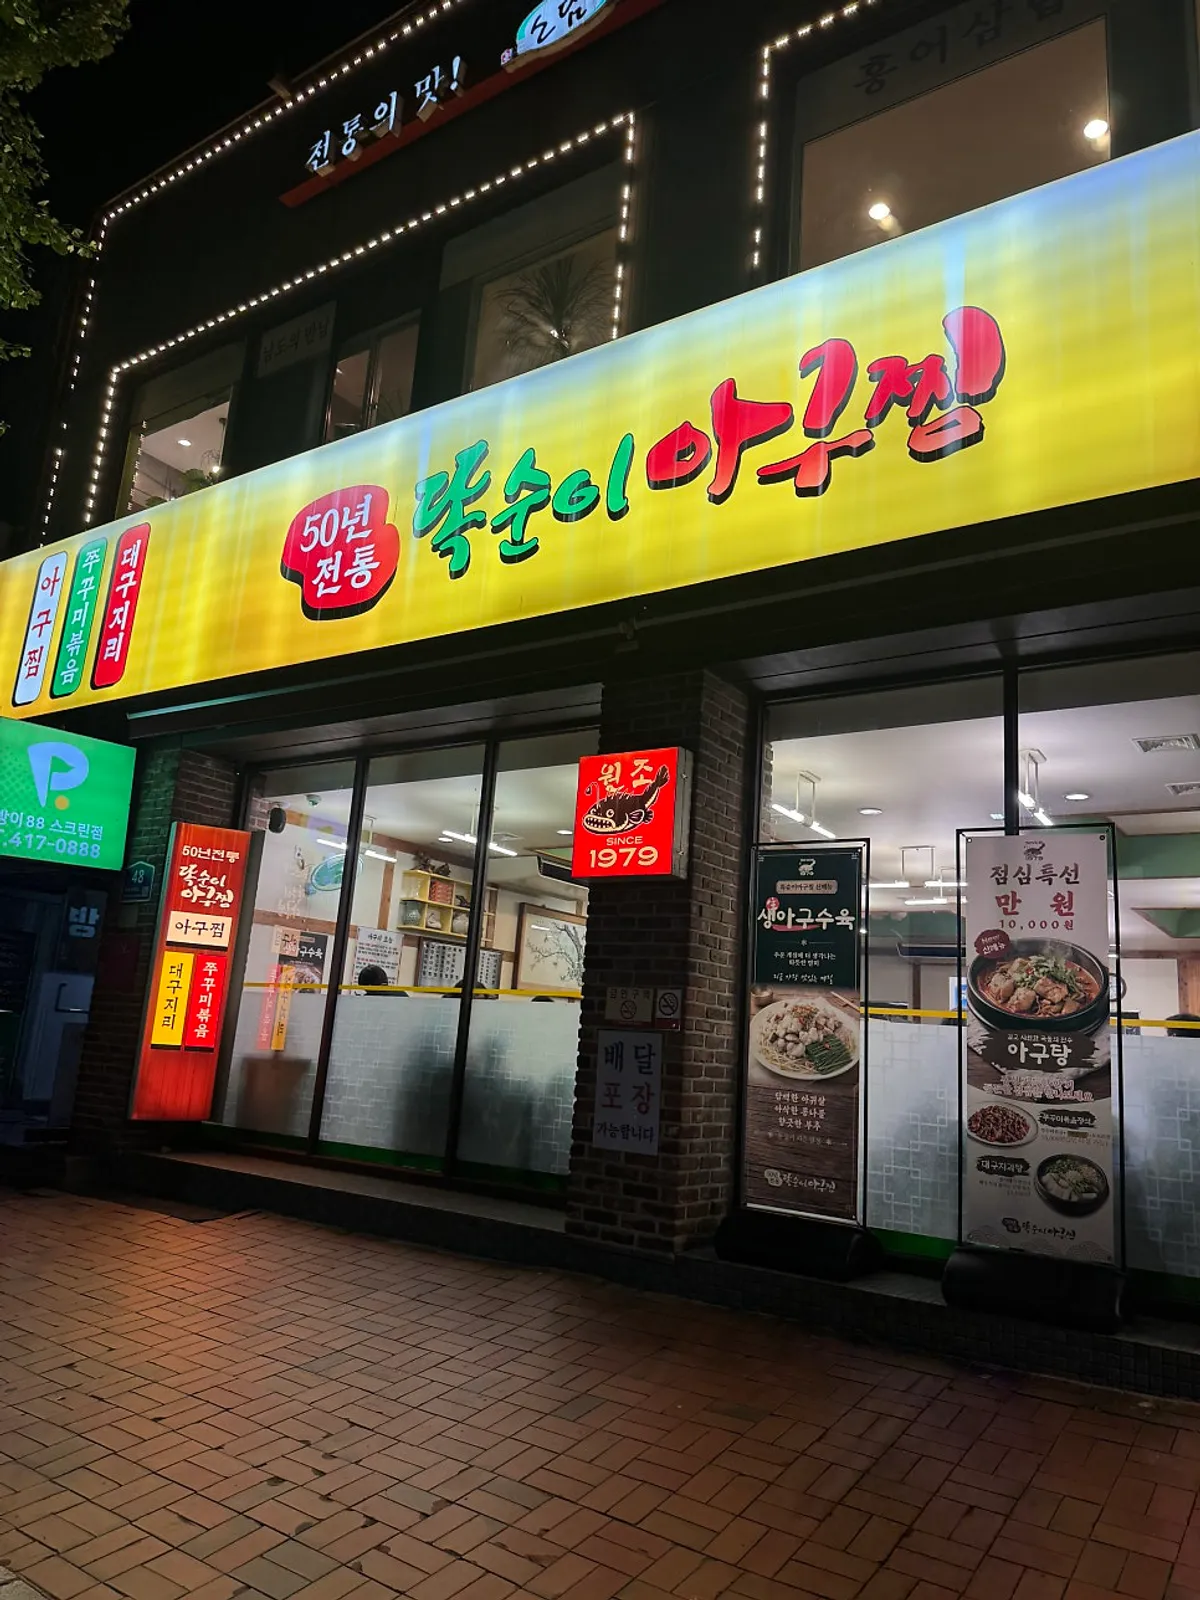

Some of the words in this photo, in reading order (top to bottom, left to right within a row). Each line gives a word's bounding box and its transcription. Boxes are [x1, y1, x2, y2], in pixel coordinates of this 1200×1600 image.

[305, 91, 398, 171] 전통의
[414, 56, 461, 111] 맛!
[646, 306, 1005, 506] 아구찜
[300, 492, 373, 552] 50년
[310, 545, 380, 599] 전통
[103, 539, 142, 663] 대구지리
[24, 566, 61, 679] 아구찜
[60, 548, 102, 688] 쭈꾸미볶음
[49, 819, 104, 841] 스크린점
[606, 836, 643, 846] SINCE
[589, 846, 659, 869] 1979
[131, 869, 145, 884] 48
[990, 862, 1080, 886] 점심특선
[181, 885, 235, 908] 아구찜
[995, 890, 1022, 916] 만
[1050, 890, 1075, 917] 원
[175, 920, 225, 939] 아구찜
[757, 906, 856, 931] 생아구수육
[1000, 919, 1074, 931] 10,000원
[160, 962, 183, 1031] 대구지리
[193, 961, 219, 1039] 쭈꾸미볶음
[604, 1041, 657, 1076] 배달
[1007, 1041, 1072, 1067] 아구탕
[602, 1082, 656, 1115] 포장
[596, 1122, 654, 1145] 가능합니다
